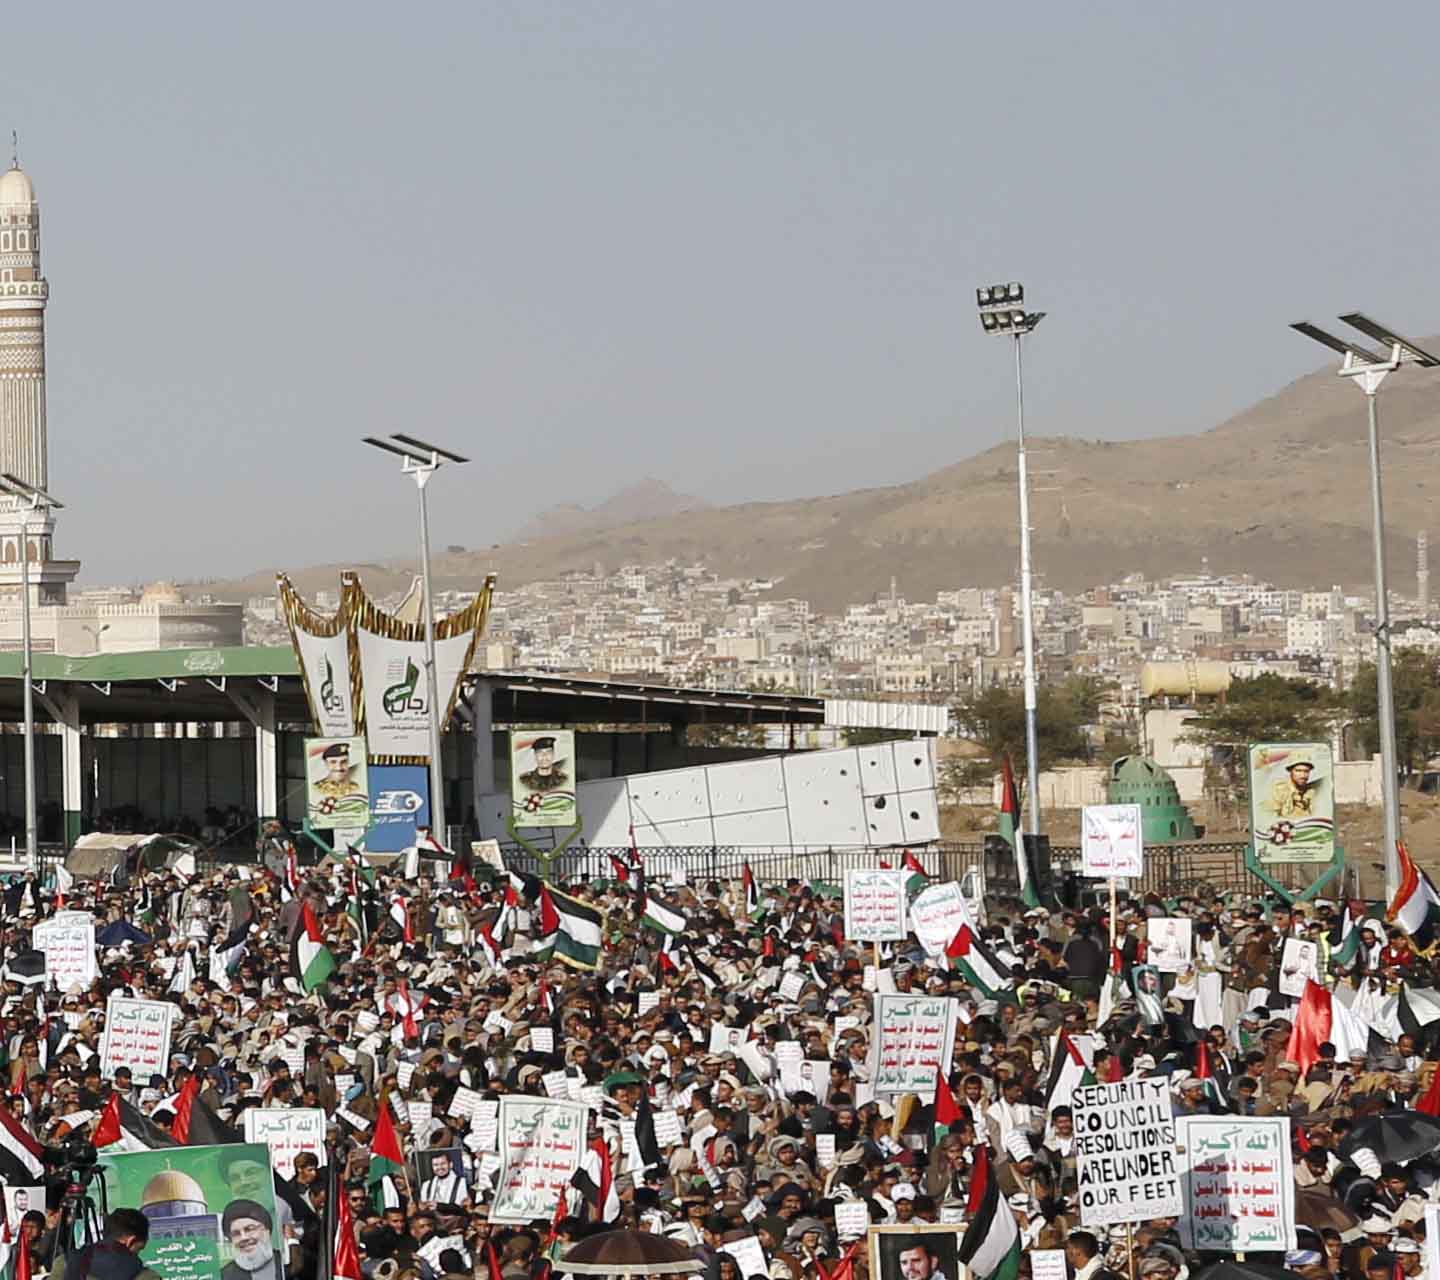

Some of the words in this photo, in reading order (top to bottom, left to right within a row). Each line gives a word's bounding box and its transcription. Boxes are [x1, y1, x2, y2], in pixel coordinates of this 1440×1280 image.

[1072, 1082, 1165, 1110] SECURITY
[1075, 1106, 1168, 1133] COUNCIL
[1076, 1126, 1175, 1156] RESOLUTIONS
[1083, 1188, 1122, 1206] OUR
[1130, 1180, 1176, 1201] FEET
